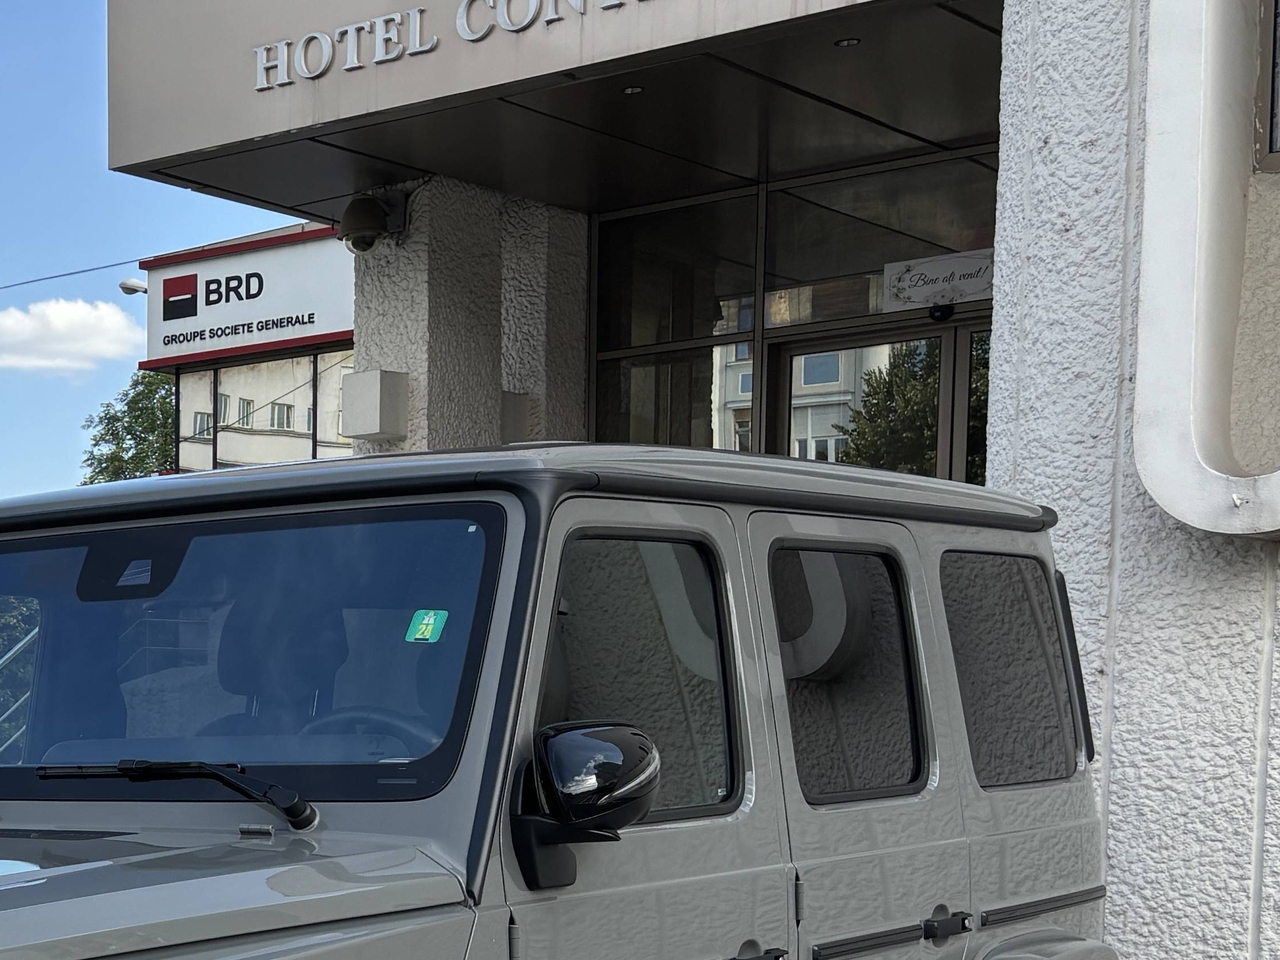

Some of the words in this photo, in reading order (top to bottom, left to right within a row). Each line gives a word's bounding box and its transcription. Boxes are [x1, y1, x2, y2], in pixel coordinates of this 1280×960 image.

[253, 6, 439, 91] HOTEL
[205, 272, 264, 306] BRD
[908, 273, 940, 289] Bine
[162, 329, 207, 346] GROUPE
[208, 322, 254, 339] SOCIETE
[256, 313, 315, 332] GENERALE
